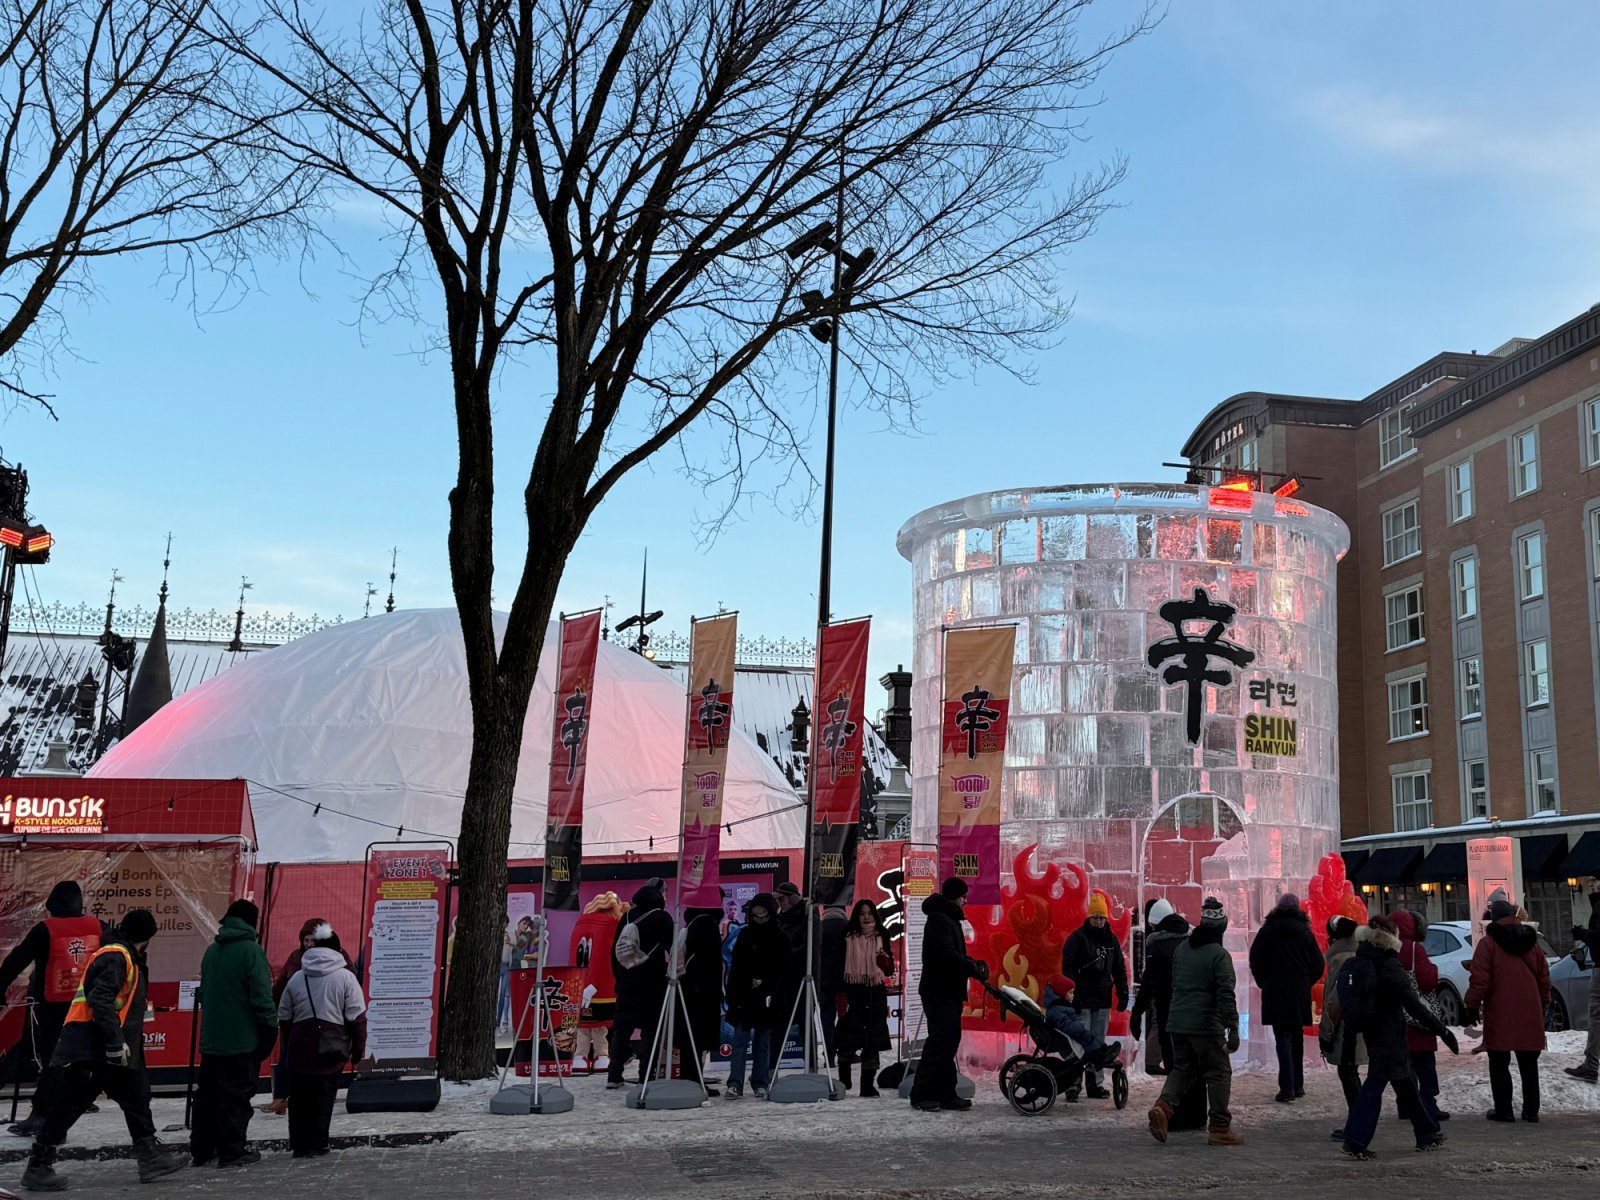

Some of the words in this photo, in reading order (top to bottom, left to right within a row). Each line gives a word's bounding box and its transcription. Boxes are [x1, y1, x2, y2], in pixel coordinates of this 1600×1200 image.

[1148, 588, 1256, 744] 辛
[1249, 678, 1297, 708] 라면
[955, 685, 1001, 760] 辛
[1245, 714, 1297, 741] SHIN
[1245, 739, 1297, 757] RAMYUN
[393, 858, 427, 868] EVENT
[820, 854, 843, 867] SHIN
[953, 854, 979, 867] SHIN
[389, 868, 419, 878] ZONE
[422, 868, 427, 878] 1
[156, 903, 180, 914] Les
[158, 918, 192, 931] uilles
[69, 939, 86, 964] 辛
